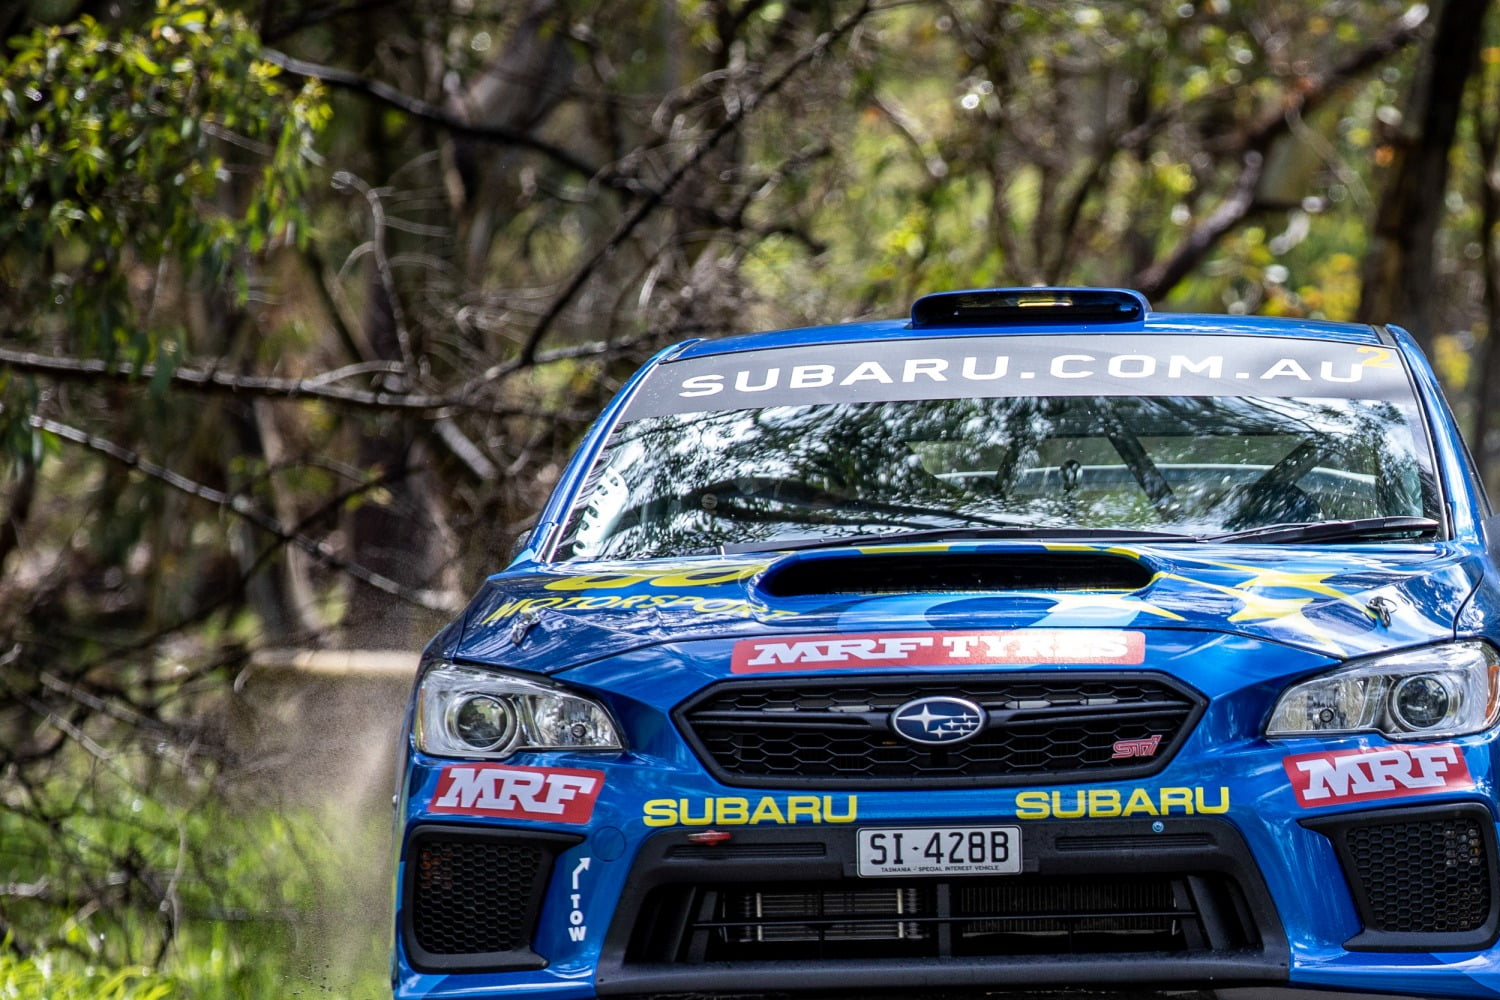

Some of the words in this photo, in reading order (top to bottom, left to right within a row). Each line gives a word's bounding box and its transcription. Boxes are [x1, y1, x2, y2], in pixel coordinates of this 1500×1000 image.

[679, 354, 1363, 397] SUBARU.COM.AU
[481, 595, 798, 624] MOTORSPORT
[747, 637, 933, 665] MRF
[435, 767, 597, 815] MRF
[1296, 747, 1459, 800] MRF
[643, 794, 858, 827] SUBARU
[1015, 786, 1230, 819] SUBARU
[568, 893, 587, 942] TOW
